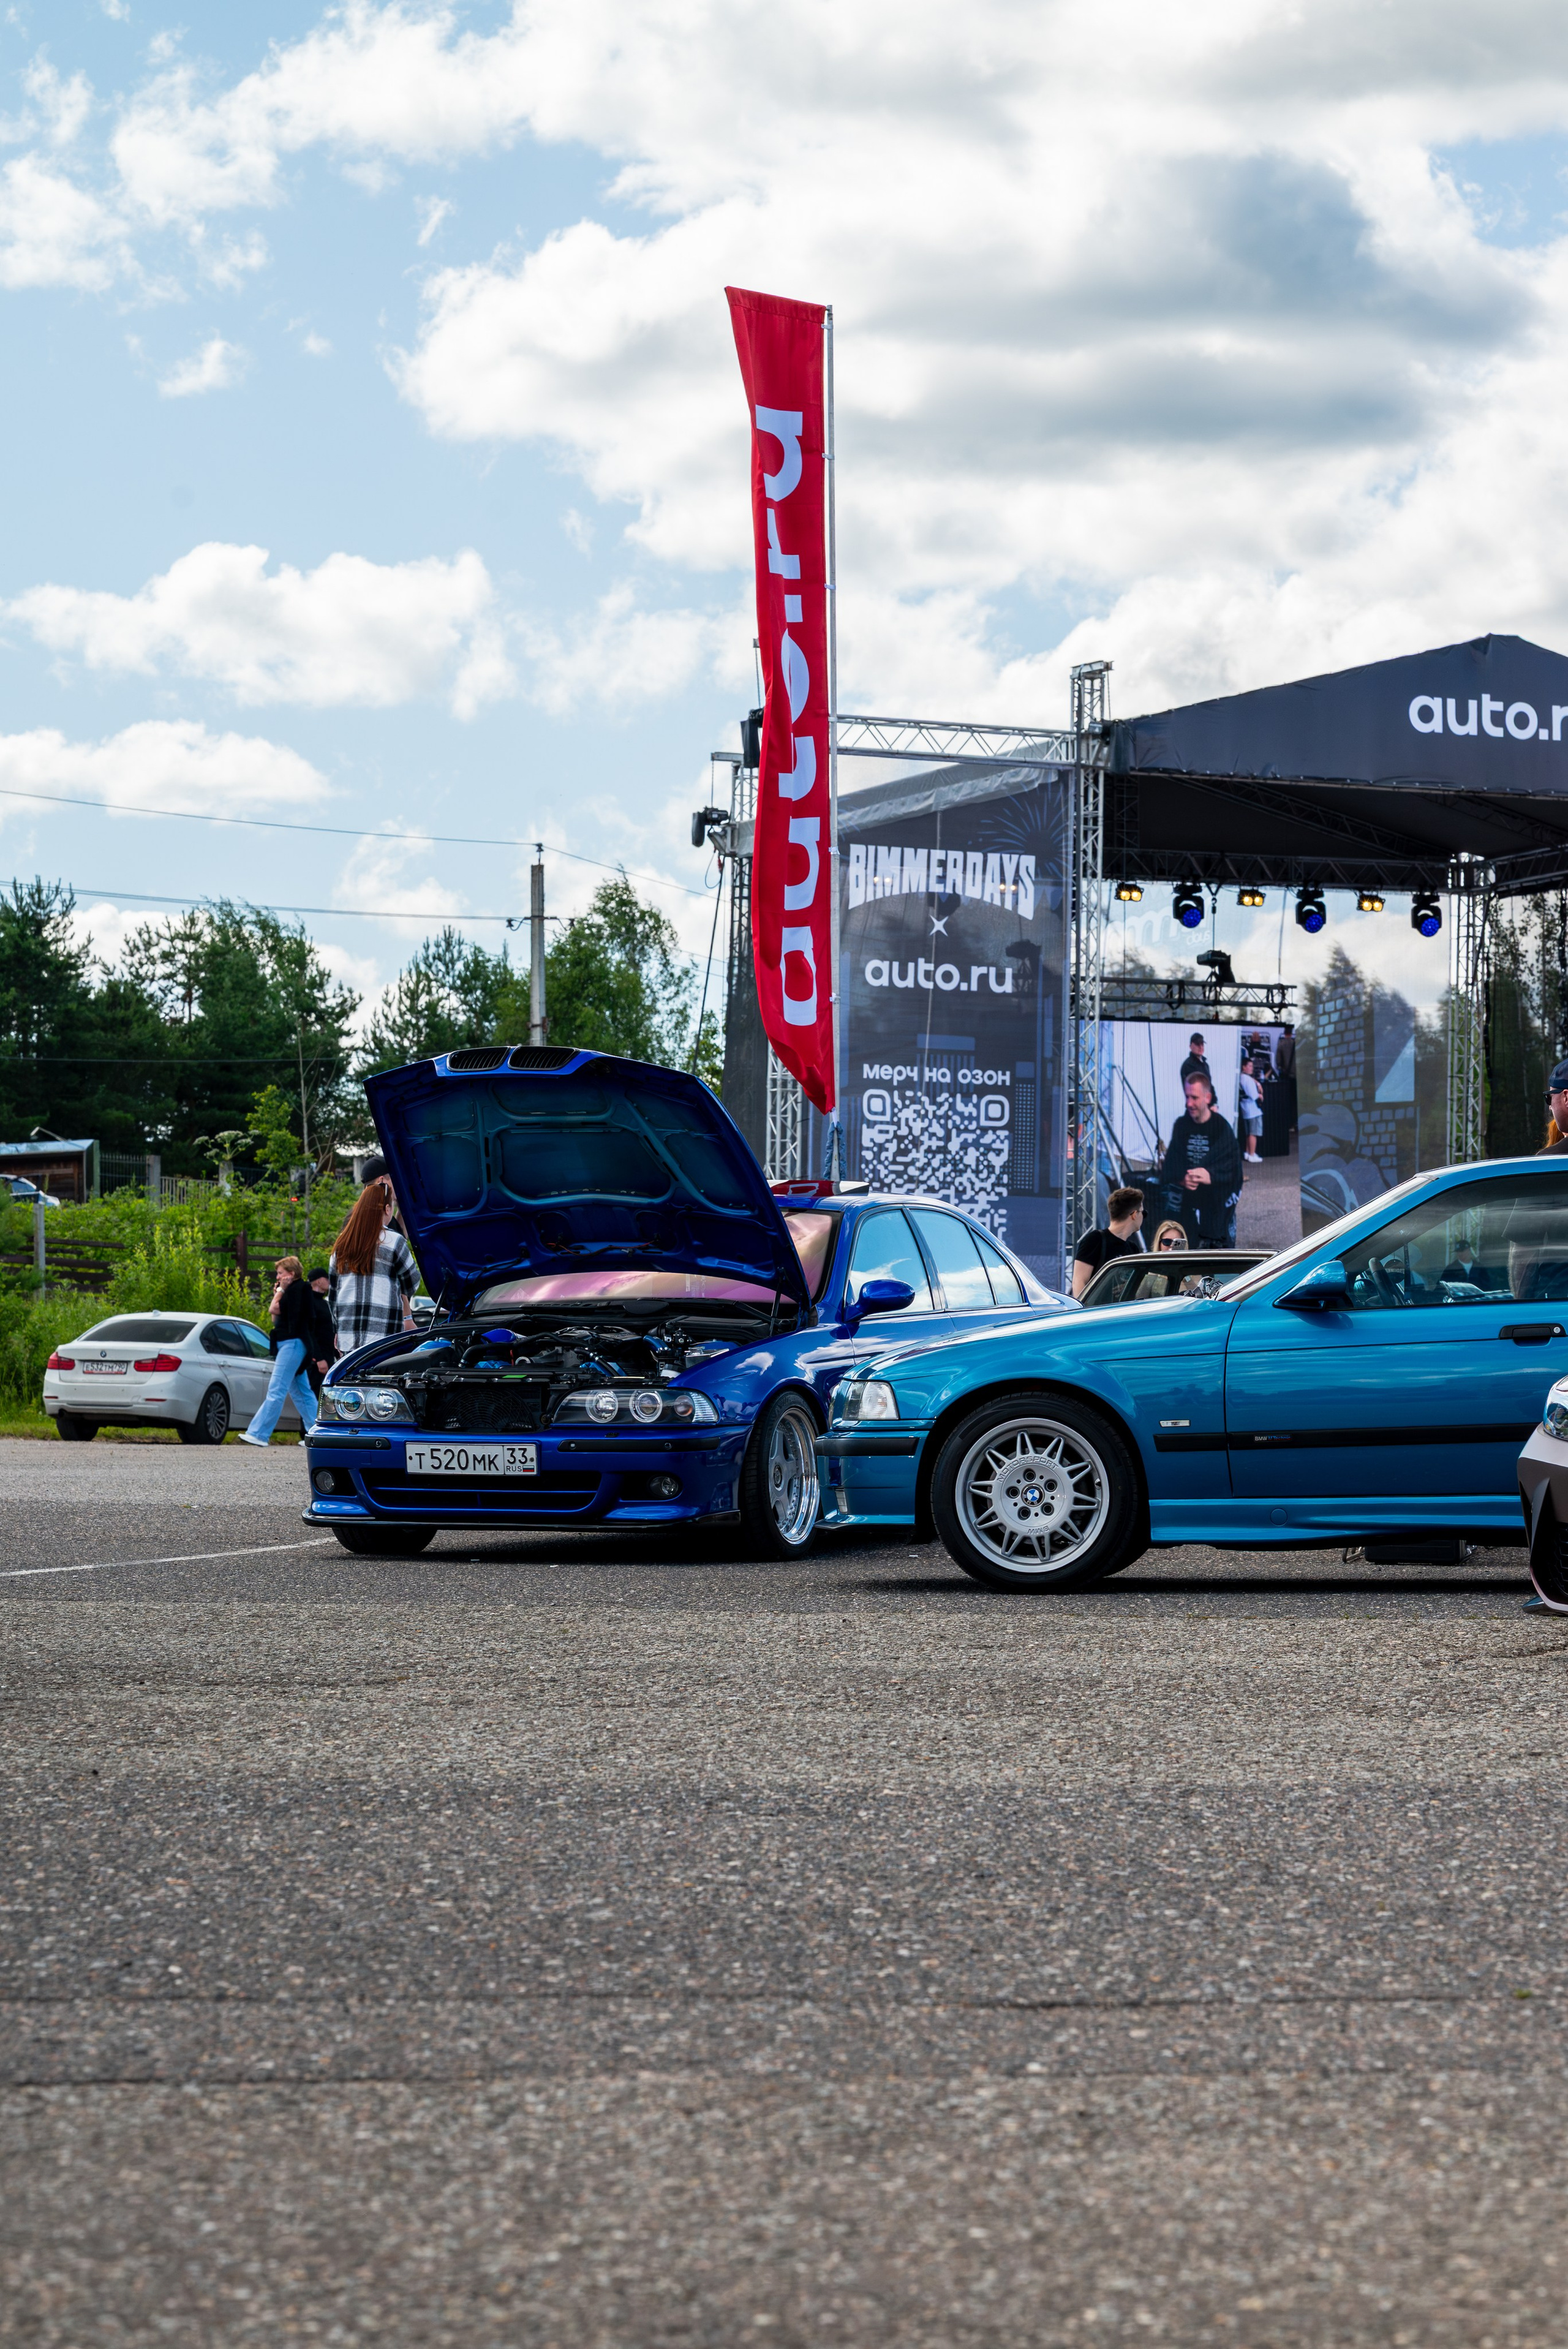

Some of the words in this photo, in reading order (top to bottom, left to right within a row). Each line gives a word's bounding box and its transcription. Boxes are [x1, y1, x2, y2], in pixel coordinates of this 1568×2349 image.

[848, 843, 1036, 920] BIMMERDAYS
[864, 957, 1012, 994] auto.ru
[862, 1063, 918, 1086] мерч
[925, 1066, 951, 1084] на
[957, 1068, 1011, 1086] озон
[507, 1447, 528, 1465] 33
[997, 1456, 1058, 1482] MOTORSPORT
[1027, 1525, 1050, 1535] BMW
